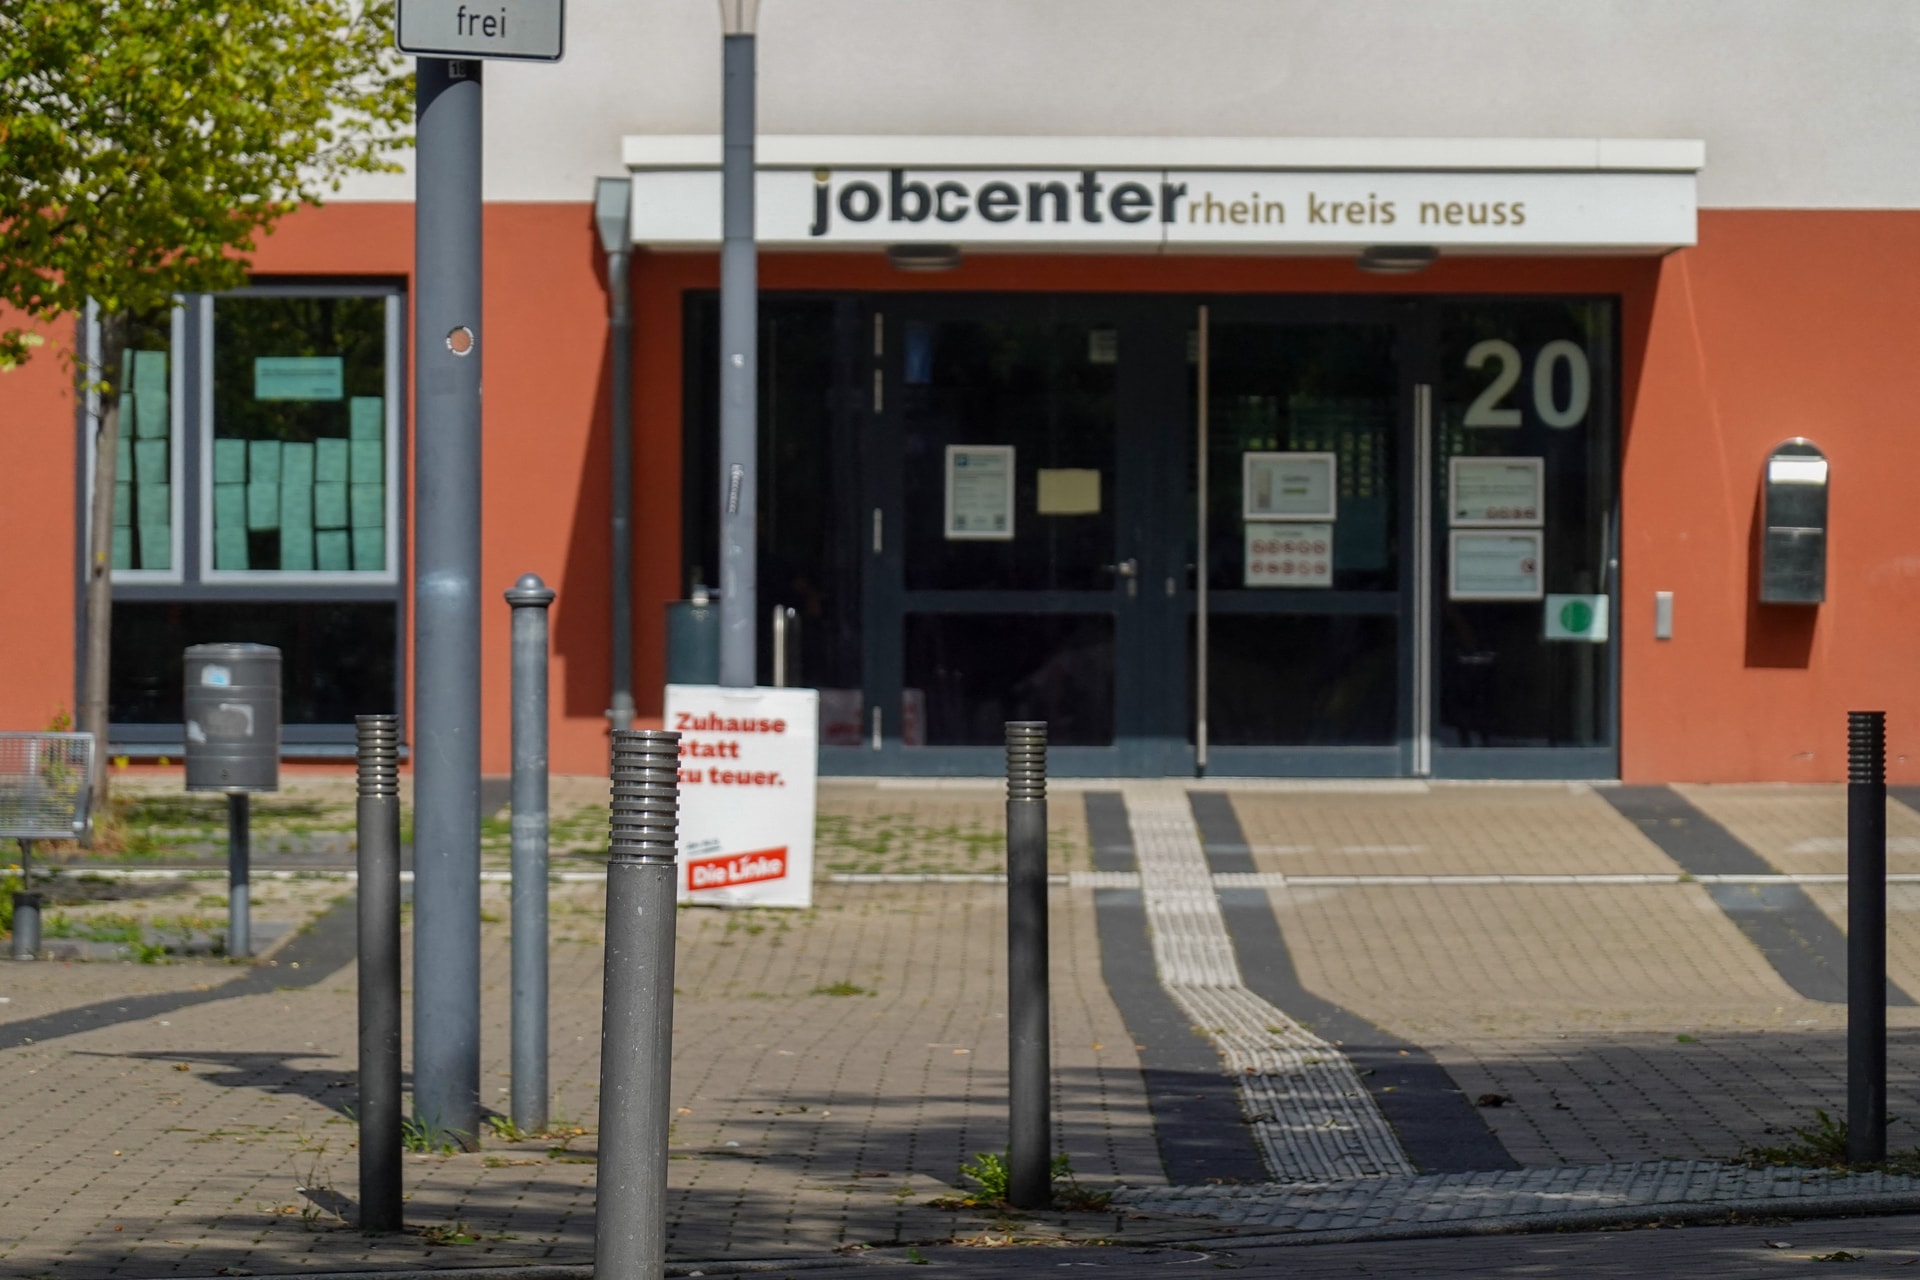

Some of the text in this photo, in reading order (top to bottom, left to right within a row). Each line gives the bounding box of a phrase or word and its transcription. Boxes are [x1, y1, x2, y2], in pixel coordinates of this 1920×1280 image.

[457, 5, 507, 37] frei
[810, 168, 1526, 236] jobcenter rhein kreis neuss
[1464, 339, 1590, 428] 20
[676, 711, 786, 733] Zuhause
[709, 766, 784, 785] teuer.
[693, 854, 783, 886] Die Linke
